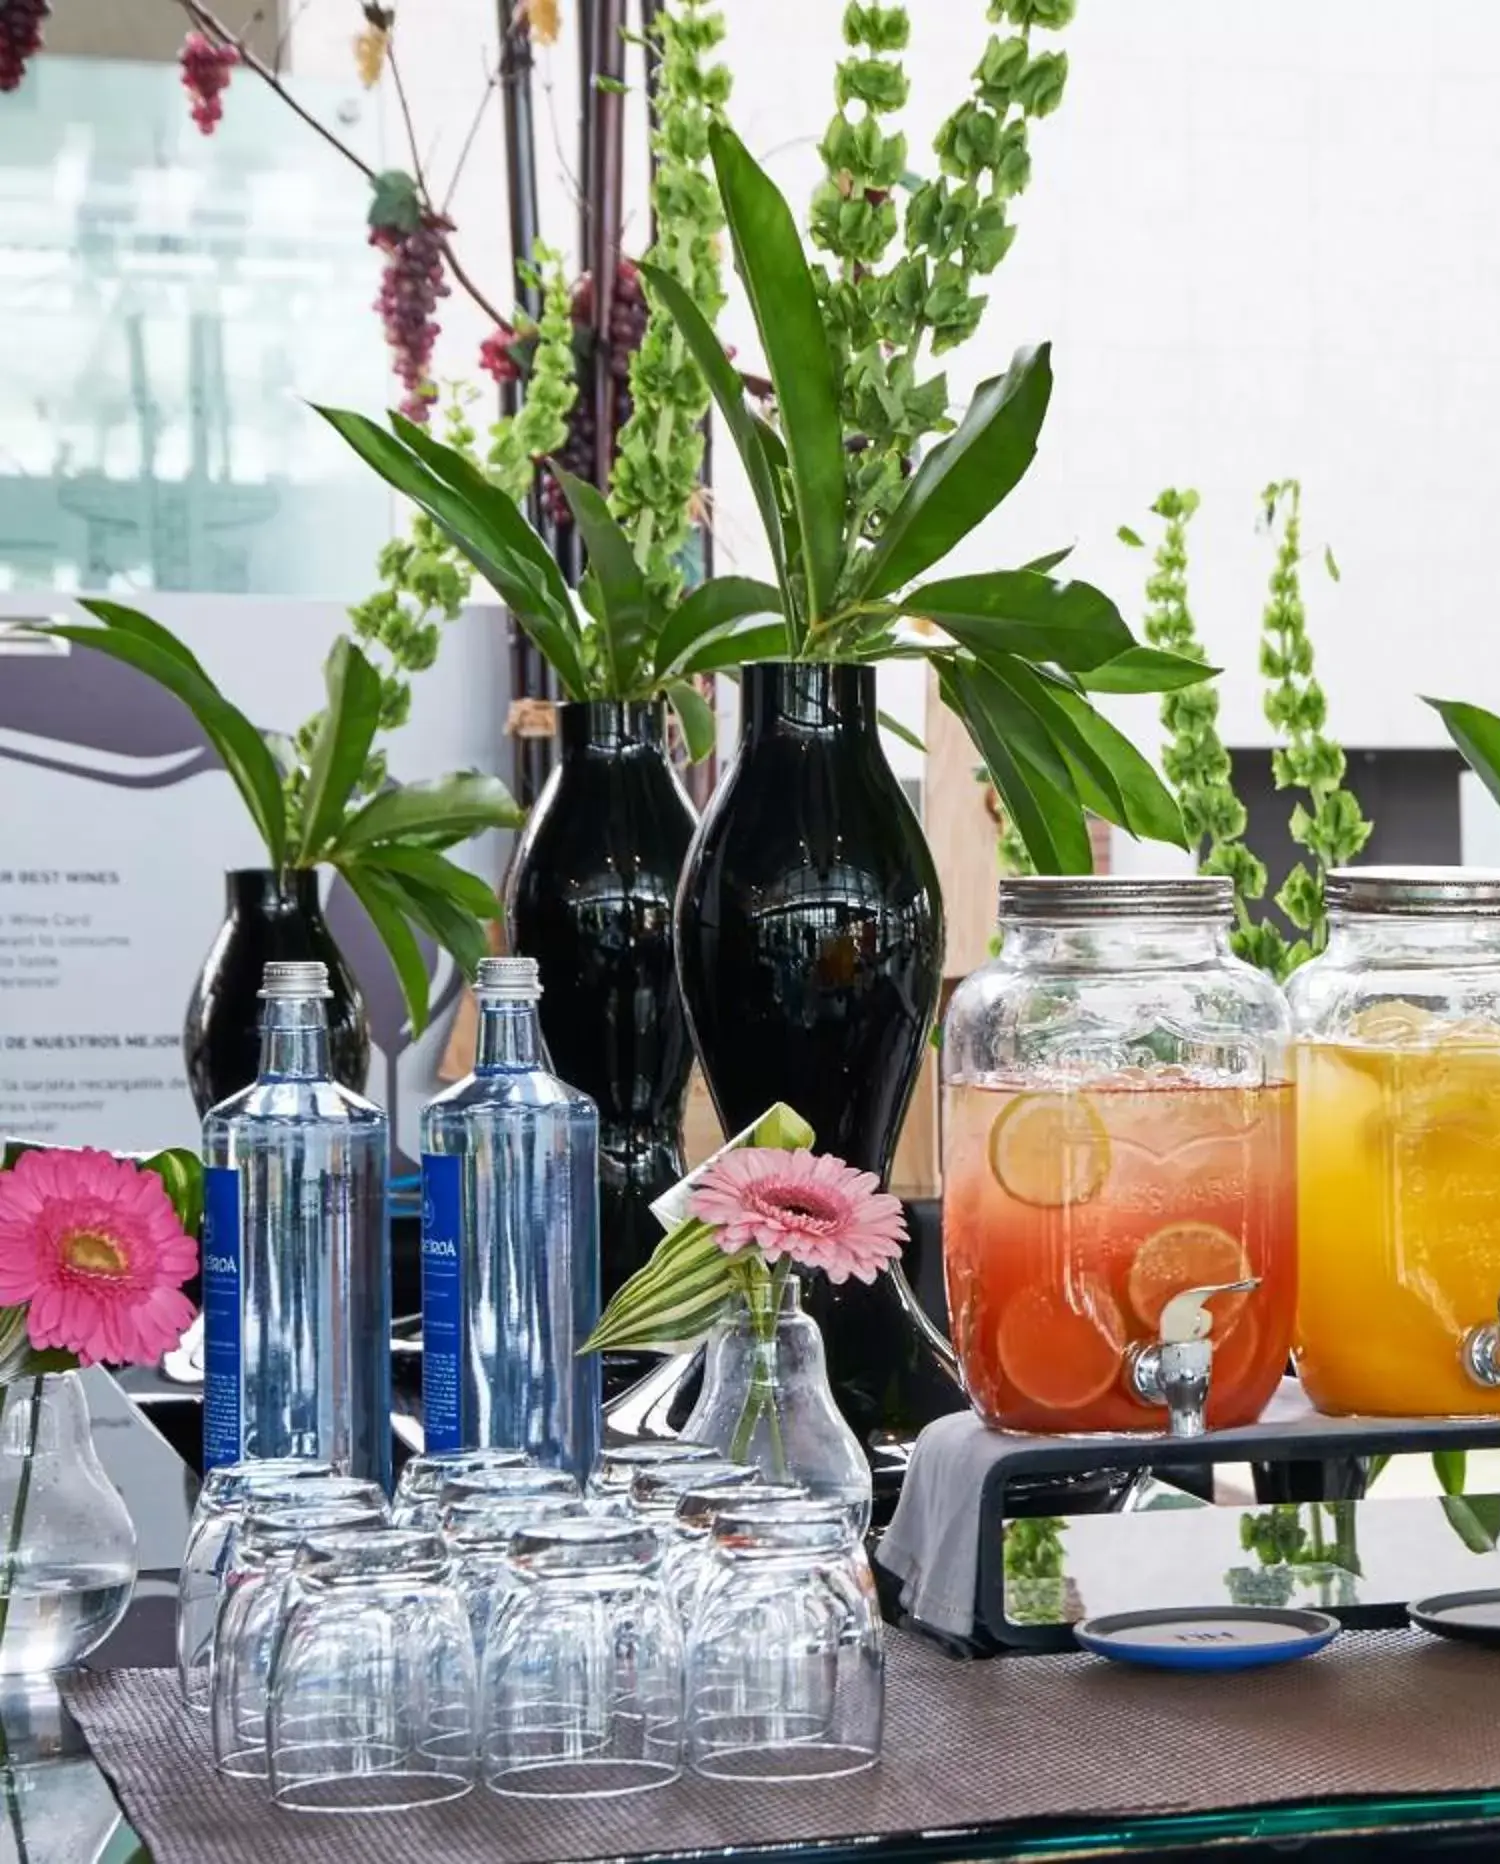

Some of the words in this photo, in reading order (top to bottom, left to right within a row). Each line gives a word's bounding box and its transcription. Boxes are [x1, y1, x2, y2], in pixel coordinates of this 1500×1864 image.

[19, 871, 60, 885] BEST
[66, 871, 120, 885] WINES
[5, 1036, 26, 1049] DE
[32, 1035, 120, 1049] NUESTROS
